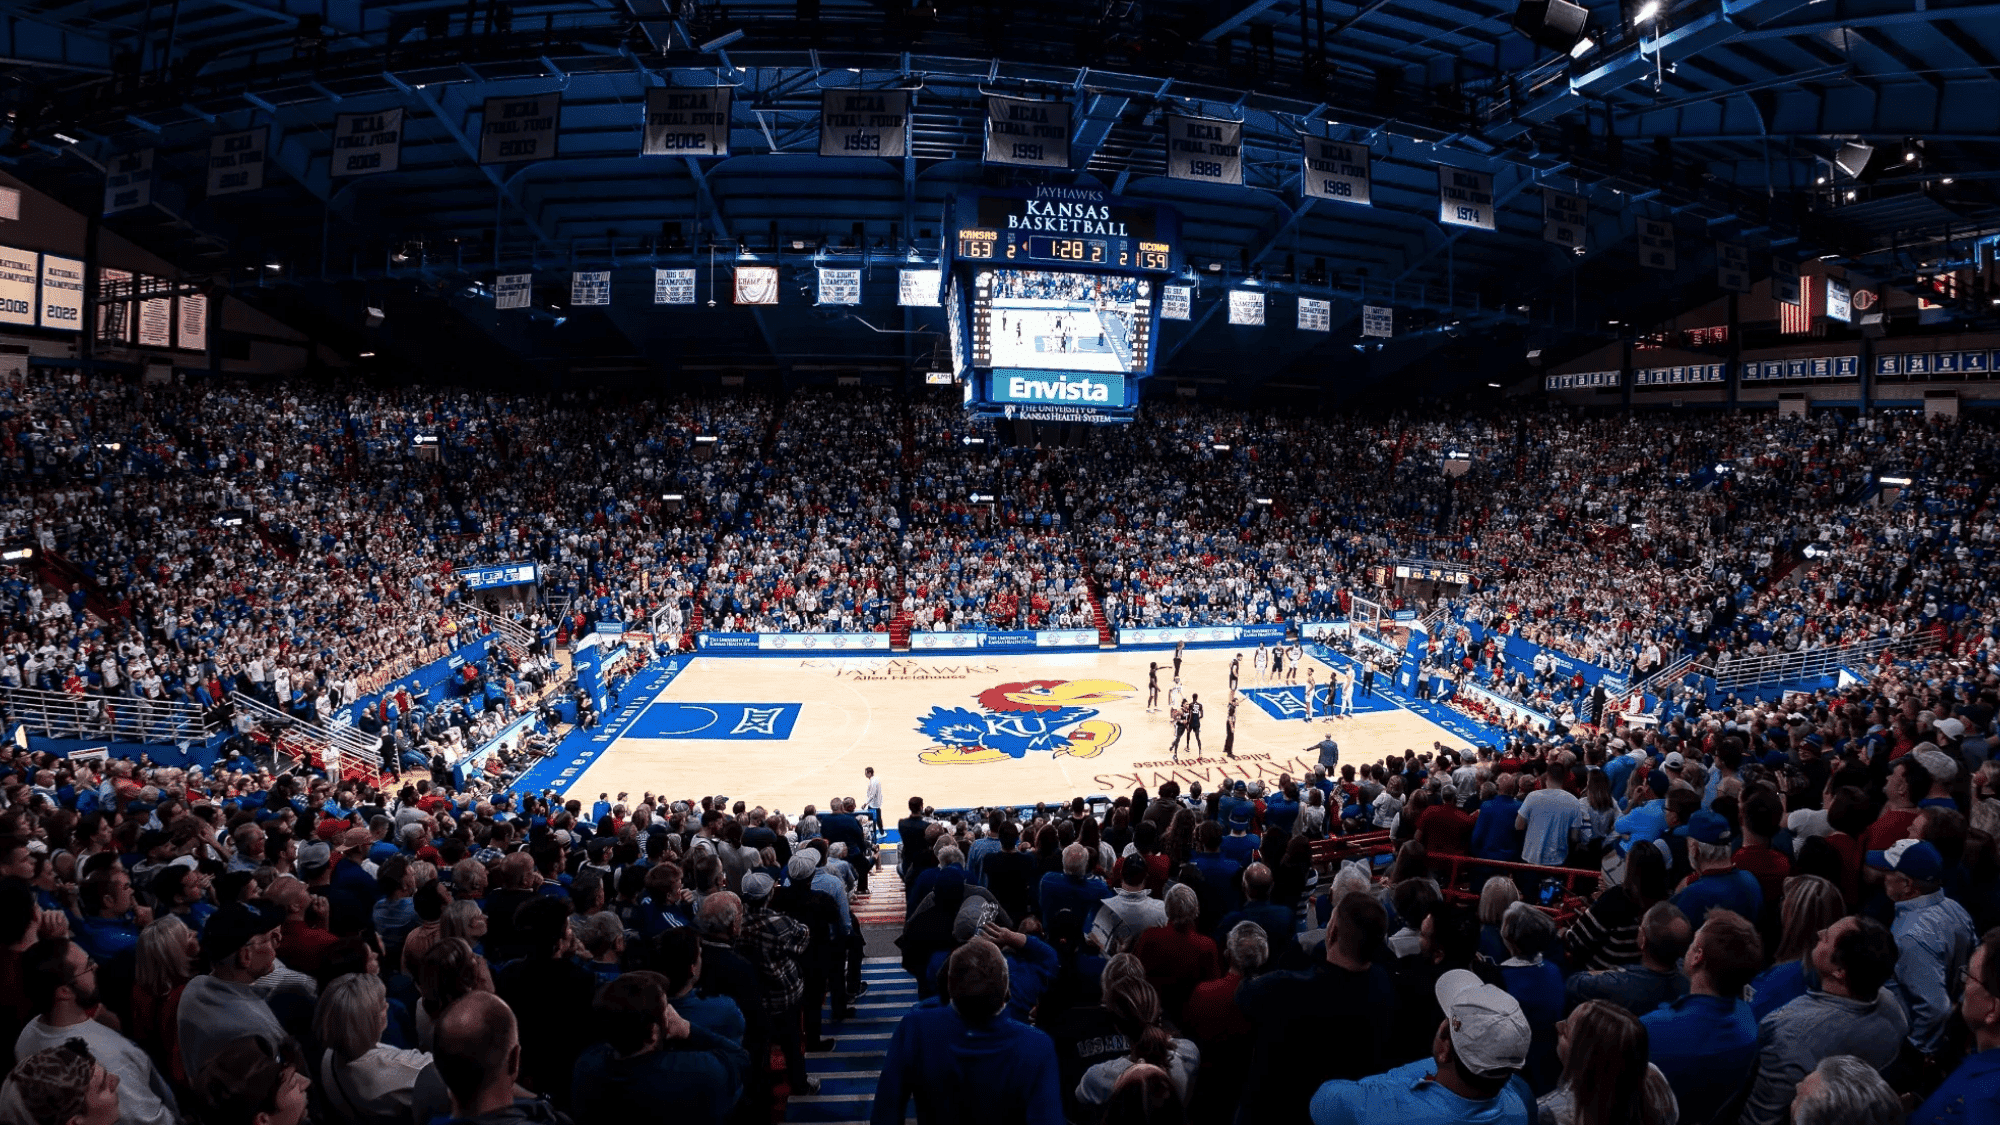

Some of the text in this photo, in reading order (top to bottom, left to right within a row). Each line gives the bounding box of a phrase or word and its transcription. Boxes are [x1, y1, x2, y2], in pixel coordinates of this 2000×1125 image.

[667, 94, 708, 110] NCAA
[846, 96, 886, 112] NCAA
[650, 112, 725, 126] FINAL FOUR
[1009, 106, 1049, 123] NCAA
[992, 121, 1065, 139] FINAL FOUR
[1187, 124, 1222, 141] NCAA
[666, 133, 706, 149] 2002
[844, 135, 881, 151] 1993
[1011, 143, 1044, 160] 1991
[1321, 144, 1353, 162] NCAA
[1190, 160, 1222, 177] 1988
[1036, 186, 1104, 201] JAYHAWKS
[1323, 180, 1352, 197] 1986
[1026, 199, 1110, 220] KANSAS
[1457, 206, 1479, 222] 1974
[1008, 214, 1128, 237] BASKETBALL
[959, 230, 998, 241] KANSAS
[971, 242, 991, 257] 63
[1007, 244, 1016, 259] 2
[1052, 240, 1083, 259] 1:28
[1092, 247, 1101, 262] 2
[1139, 241, 1170, 253] UCONN
[1119, 252, 1128, 266] 2
[1147, 253, 1166, 268] 59
[48, 267, 79, 280] NATIONAL
[837, 271, 857, 279] EIGHT
[44, 278, 83, 292] CHAMPIONS
[657, 278, 694, 286] CHAMPIONS
[821, 278, 859, 286] CHAMPIONS
[0, 297, 28, 314] 2008
[47, 304, 77, 321] 2022
[1883, 360, 1895, 370] 45
[1911, 358, 1923, 369] 34
[1942, 357, 1950, 367] 0
[1971, 356, 1978, 367] 4
[1009, 374, 1109, 402] Envista
[1020, 411, 1112, 423] KANSAS HEALTH SYSTEM
[1021, 404, 1098, 415] THE UNIVERSITY OF
[800, 659, 918, 668] KANSAS
[834, 665, 999, 677] JAYHAWKS
[592, 696, 650, 742] Naismith
[1371, 683, 1430, 714] aismith
[1441, 720, 1488, 744] Cour
[981, 716, 1047, 738] KU
[1132, 756, 1229, 769] Fieldhouse
[1093, 755, 1313, 791] JAYHAWKS
[1076, 1036, 1105, 1059] LOS
